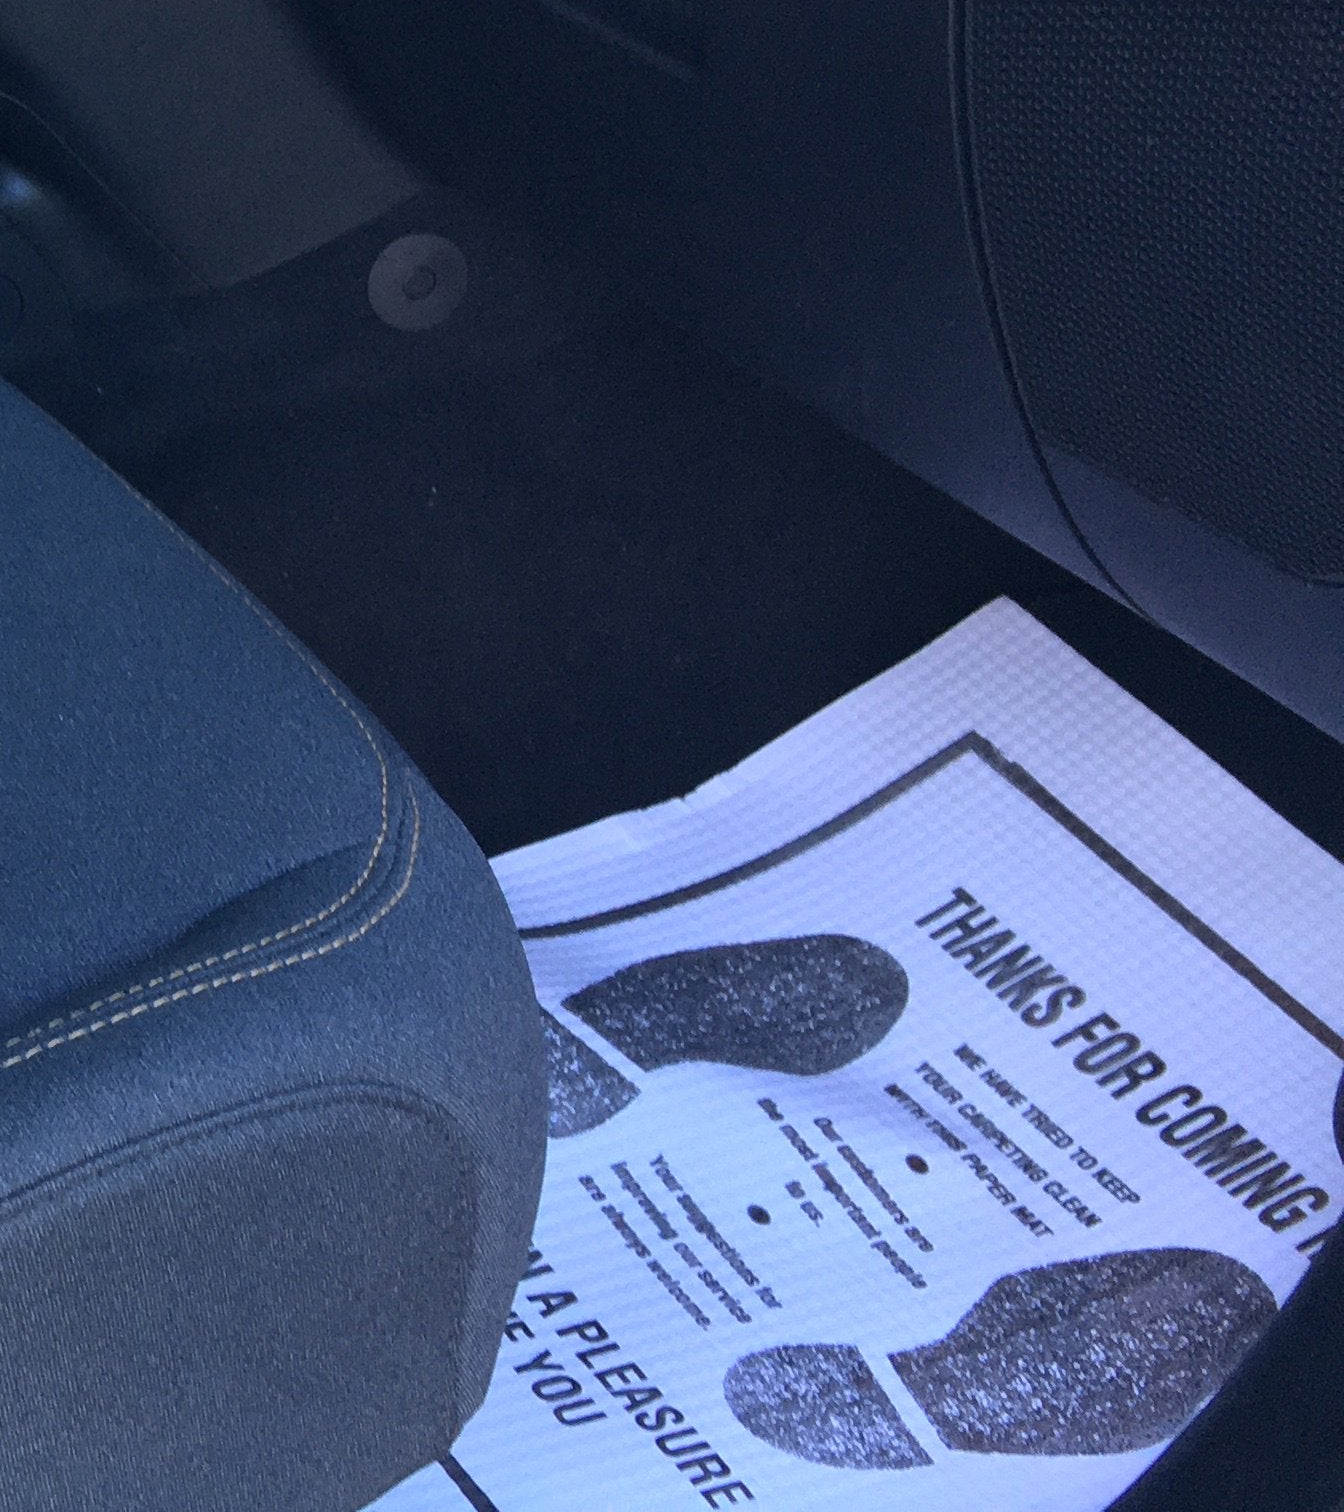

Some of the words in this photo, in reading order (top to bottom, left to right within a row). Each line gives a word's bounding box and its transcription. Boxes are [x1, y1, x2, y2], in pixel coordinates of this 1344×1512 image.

[914, 886, 1087, 1029] THANKS
[1050, 1010, 1168, 1100] FOR
[1135, 1084, 1330, 1234] COMING
[953, 1042, 988, 1072] WE
[980, 1068, 1028, 1108] HAVE
[1021, 1103, 1074, 1150] TRIED
[1069, 1146, 1099, 1171] TO
[1091, 1167, 1142, 1204] KEEP
[577, 1174, 607, 1202] are
[601, 1204, 652, 1258] always
[757, 1098, 785, 1122] the
[779, 1124, 820, 1163] most
[811, 1161, 883, 1240] important
[870, 1239, 928, 1289] people
[784, 1180, 806, 1199] to
[814, 1117, 844, 1143] Our
[837, 1144, 910, 1225] customers
[904, 1226, 934, 1253] are
[883, 1082, 930, 1121] WITH
[926, 1119, 968, 1152] THIS
[960, 1153, 1017, 1207] PAPER
[1010, 1205, 1055, 1238] MAT
[915, 1061, 963, 1105] YOUR
[958, 1103, 1049, 1184] CARPETING
[1042, 1180, 1103, 1228] CLEAN
[610, 1160, 679, 1241] improving
[673, 1241, 703, 1268] our
[697, 1269, 753, 1324] service
[650, 1154, 684, 1192] Your
[677, 1194, 760, 1287] suggestions
[755, 1286, 783, 1309] for
[512, 1349, 608, 1427] YOU
[525, 1290, 579, 1319] A
[555, 1319, 755, 1510] PLEASURE
